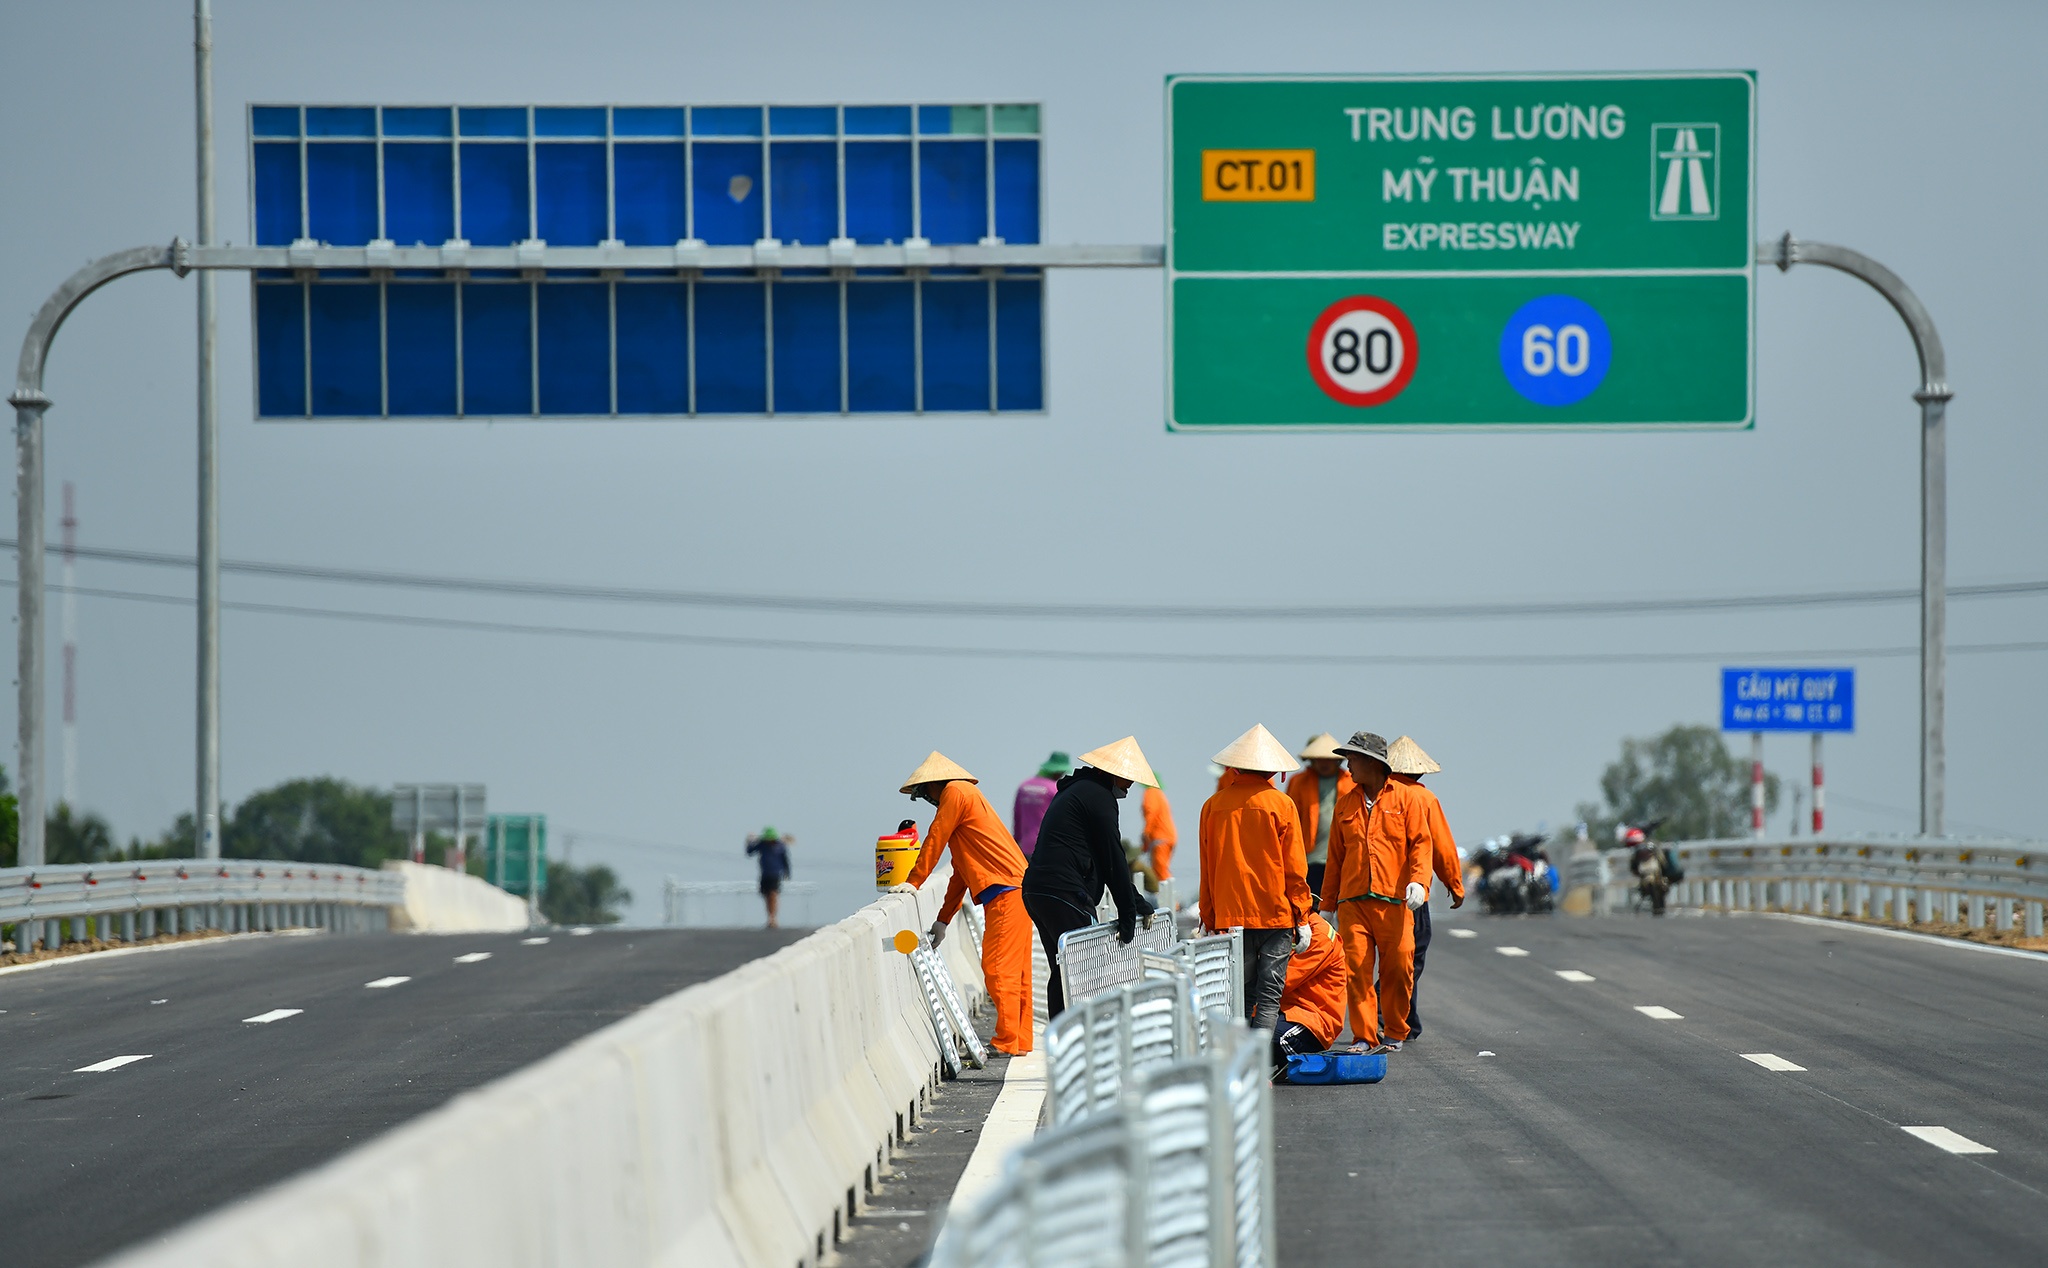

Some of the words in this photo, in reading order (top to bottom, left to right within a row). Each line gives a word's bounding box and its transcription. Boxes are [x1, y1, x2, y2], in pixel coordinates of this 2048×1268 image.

[1344, 107, 1476, 141] TRUNG
[1492, 103, 1626, 140] LƯƠNG
[1216, 160, 1302, 192] CT.01
[1383, 156, 1438, 202] MỸ
[1447, 157, 1580, 210] THUẬN
[1383, 222, 1581, 250] EXPRESSWAY
[1331, 327, 1394, 376] 80
[1523, 325, 1589, 376] 60
